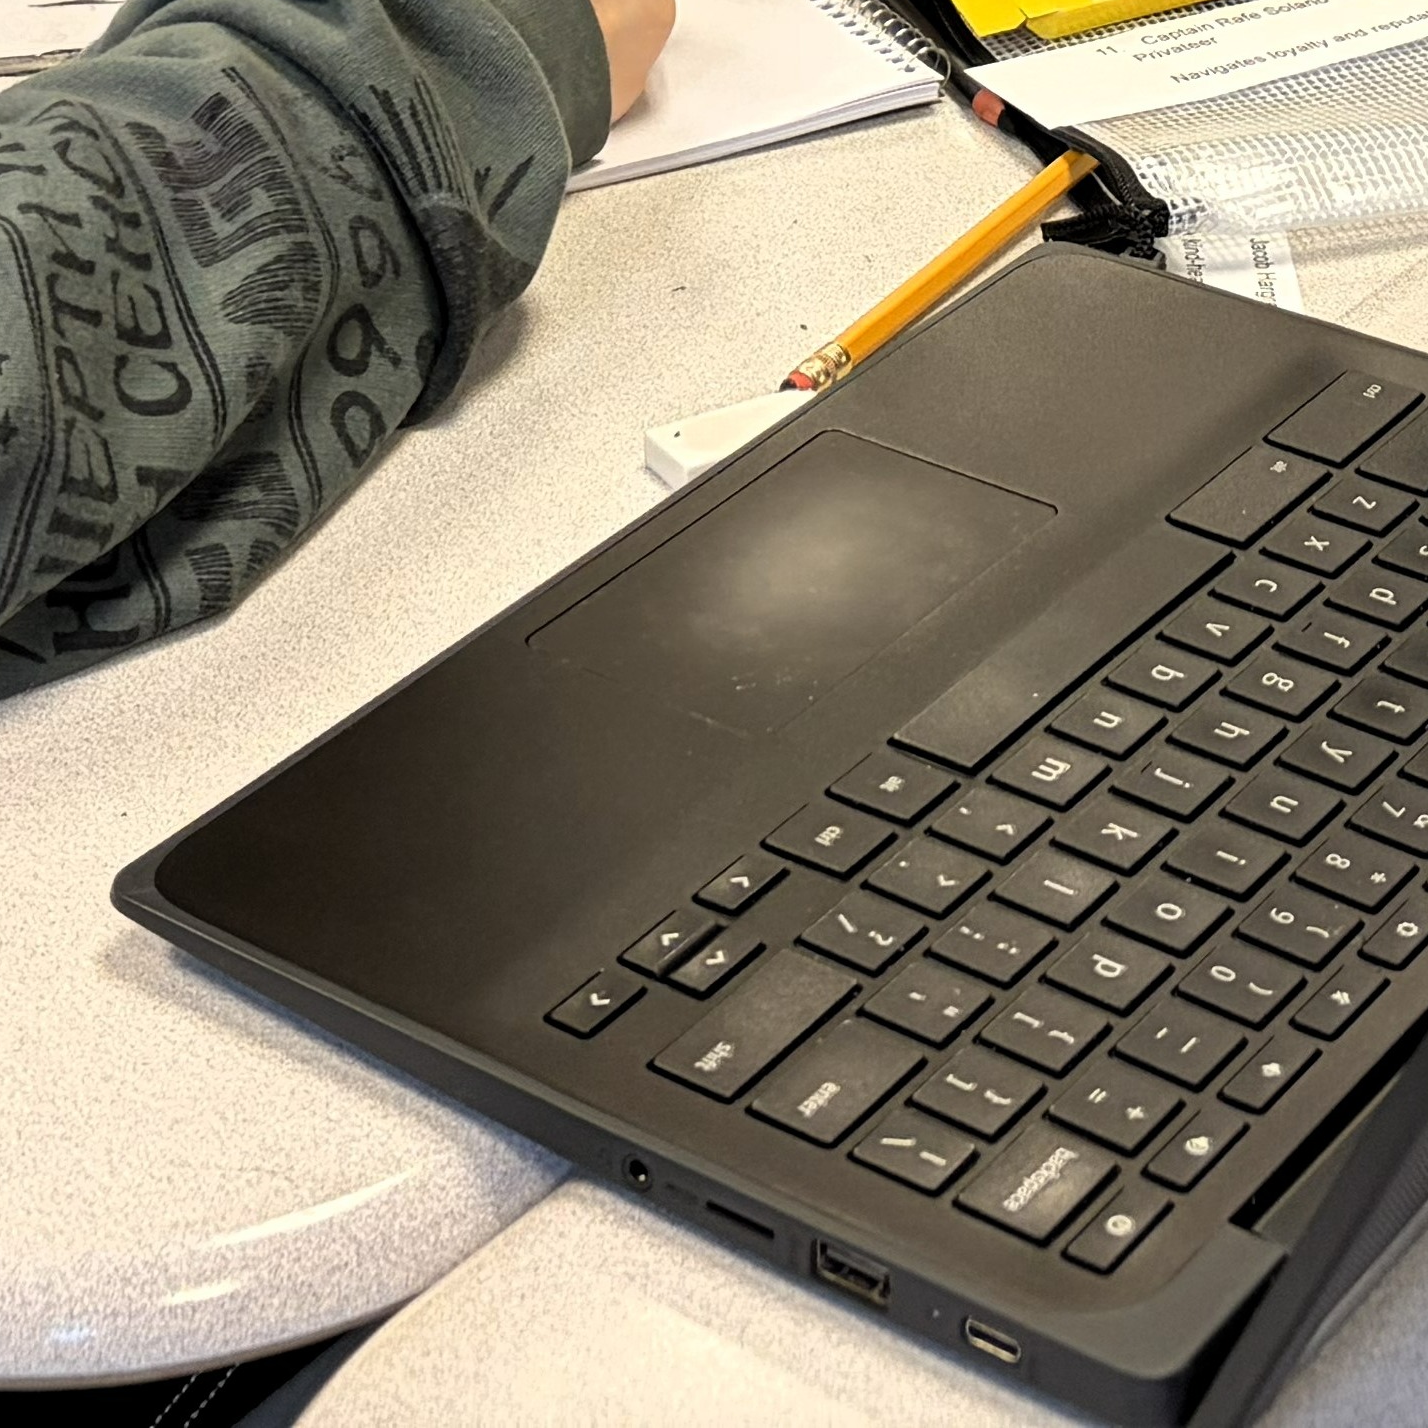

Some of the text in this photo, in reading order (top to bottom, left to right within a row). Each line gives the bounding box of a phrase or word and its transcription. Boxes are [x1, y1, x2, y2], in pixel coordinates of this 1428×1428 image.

[1140, 23, 1215, 46] Captain
[1215, 9, 1262, 28] Rafe
[1132, 36, 1219, 63] Privateer
[1170, 55, 1267, 84] Navigates
[1267, 37, 1330, 61] loyalty
[1332, 27, 1369, 43] and
[1249, 237, 1275, 270] Jacob
[1352, 495, 1377, 510] z
[1304, 535, 1330, 551] x
[1254, 579, 1278, 593] c
[1369, 587, 1397, 605] d
[1205, 622, 1230, 637] v
[1323, 632, 1350, 649] f
[1151, 664, 1185, 681] b
[1262, 672, 1294, 692] g
[1377, 700, 1405, 713] t
[1093, 711, 1123, 728] n
[1214, 722, 1250, 738] h
[1321, 741, 1353, 763] y
[1031, 757, 1071, 781] m
[1154, 767, 1191, 789] j
[1270, 795, 1299, 813] u
[1382, 801, 1406, 818] 7
[1101, 822, 1138, 841] k
[1216, 850, 1246, 865] i
[1325, 853, 1351, 869] 8
[1270, 907, 1295, 924] 9
[1092, 954, 1126, 978] p
[1003, 1147, 1077, 1212] backspace
